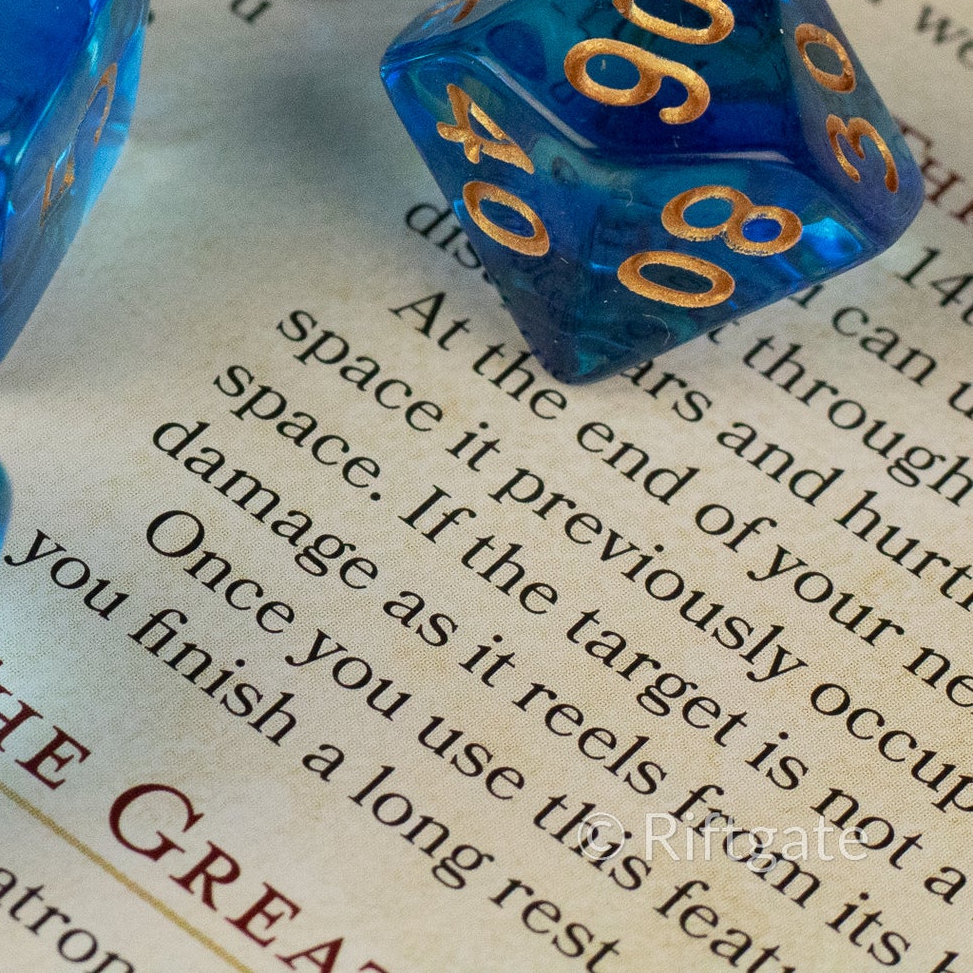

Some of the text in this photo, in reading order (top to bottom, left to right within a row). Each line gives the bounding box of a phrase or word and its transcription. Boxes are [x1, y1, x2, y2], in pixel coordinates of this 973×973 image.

[276, 309, 443, 432] space
[446, 421, 500, 472] it
[489, 467, 808, 683] previously
[390, 290, 470, 350] At
[472, 342, 584, 420] the
[576, 421, 700, 505] end
[694, 503, 778, 553] of
[746, 545, 905, 646] your
[716, 422, 845, 506] and
[742, 335, 973, 506] through
[831, 306, 938, 386] can
[3, 529, 619, 973] you finish a long rest
[146, 510, 295, 634] Once
[284, 629, 412, 720] you
[417, 715, 525, 800] use
[533, 794, 652, 891] this
[152, 421, 911, 967] damage as it reels from its
[213, 364, 967, 905] space. If the target is not a
